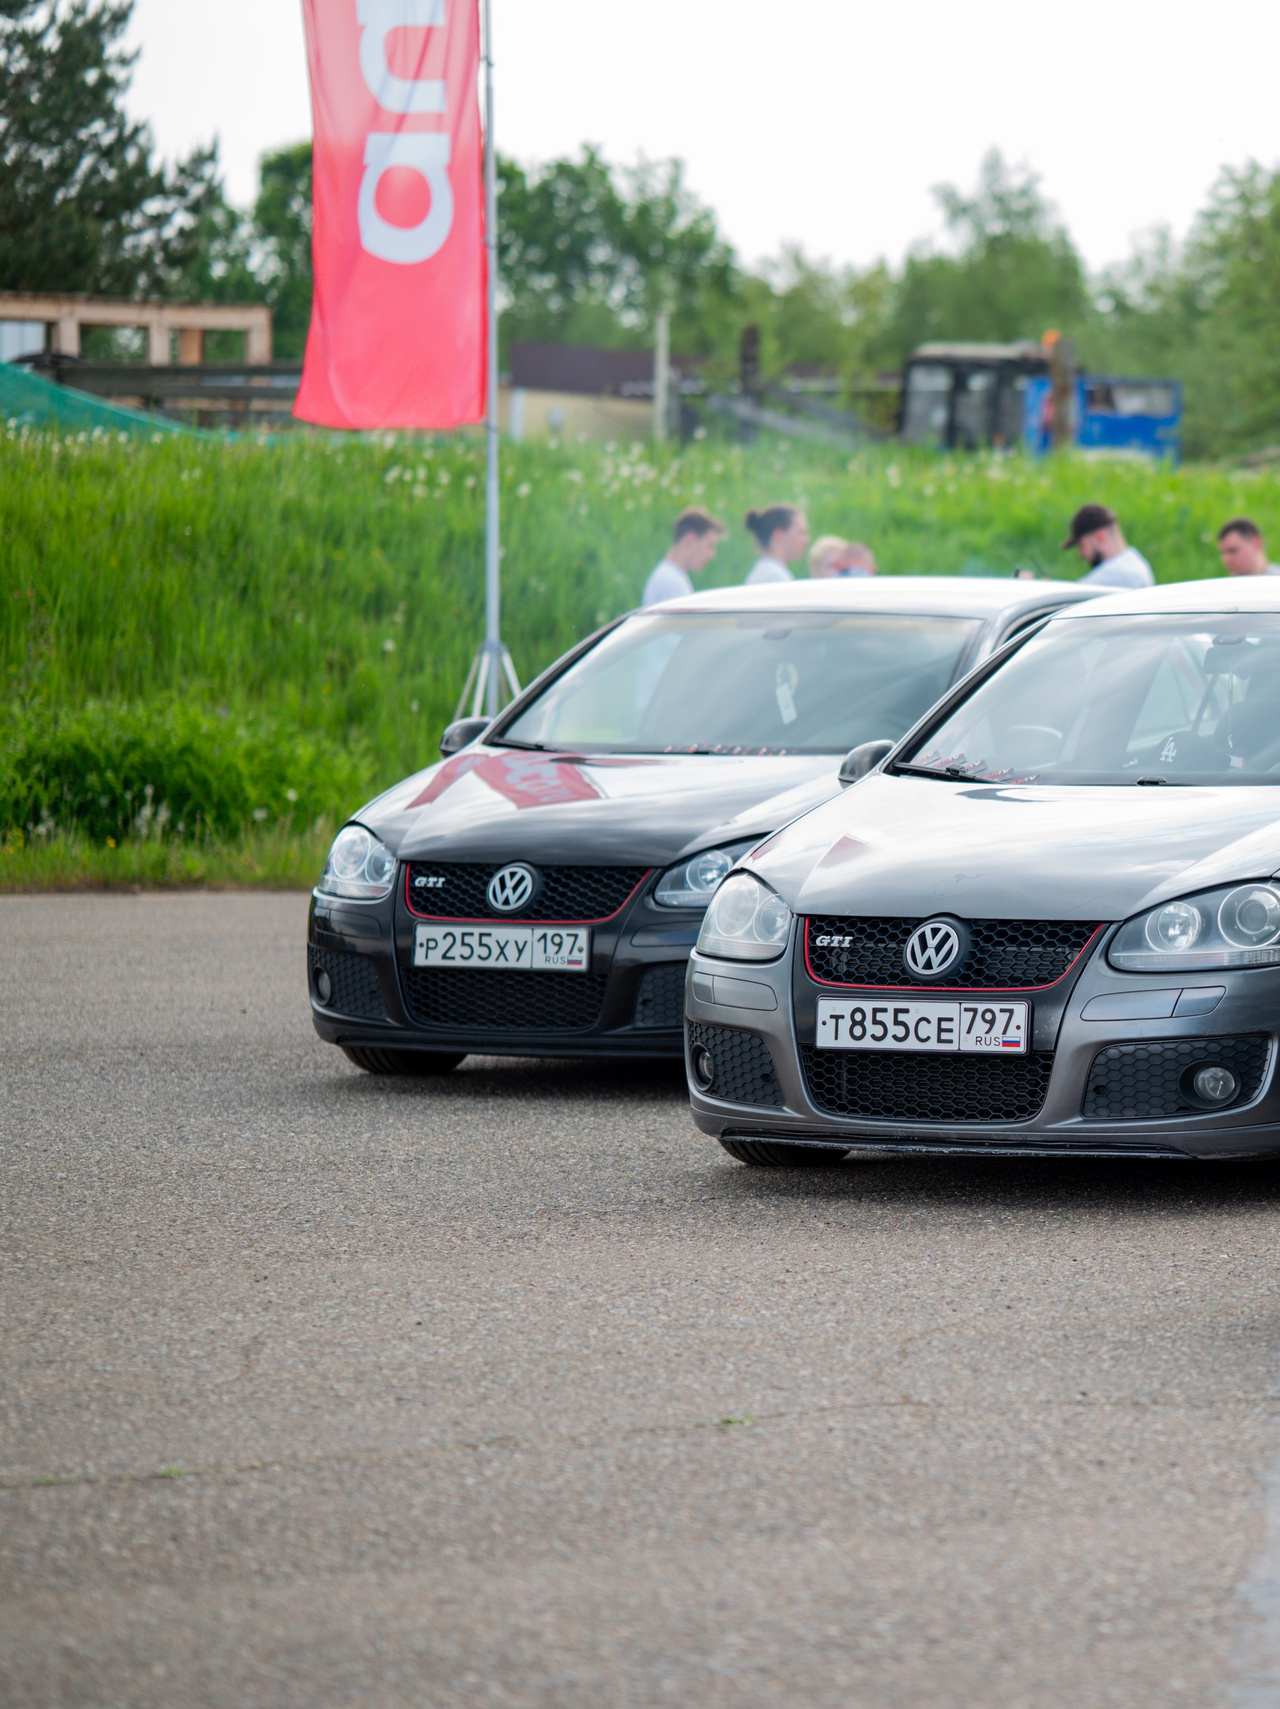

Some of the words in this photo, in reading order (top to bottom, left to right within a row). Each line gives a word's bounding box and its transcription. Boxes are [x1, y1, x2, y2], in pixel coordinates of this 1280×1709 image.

[414, 876, 446, 888] GTI
[537, 932, 579, 955] 197
[815, 935, 853, 948] GTI
[545, 956, 566, 965] RUS
[963, 1007, 1015, 1035] 797
[975, 1036, 1001, 1047] RUS
